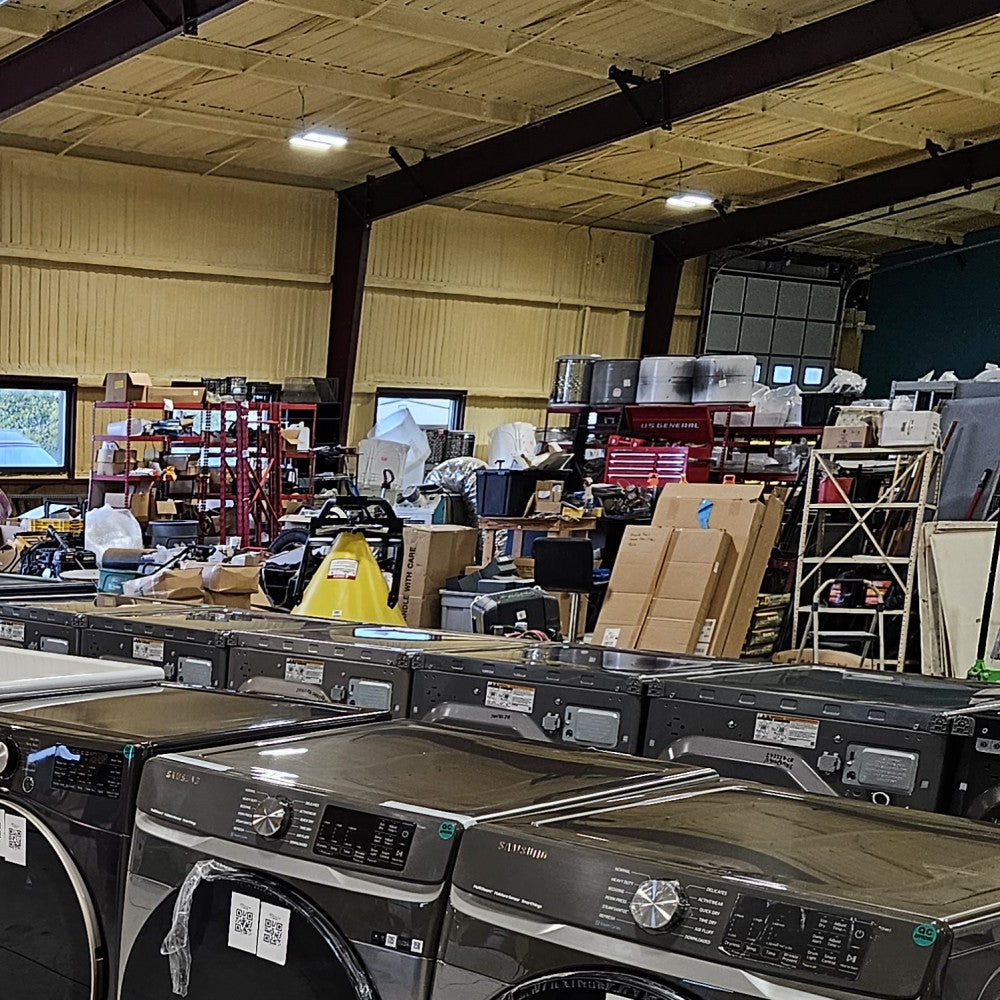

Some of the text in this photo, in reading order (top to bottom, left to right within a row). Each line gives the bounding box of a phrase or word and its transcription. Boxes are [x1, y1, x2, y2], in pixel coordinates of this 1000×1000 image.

[402, 546, 417, 622] ANDLE WITH CARE
[705, 887, 728, 896] DELICATES
[697, 897, 724, 906] ACTIVEWEAR
[918, 926, 934, 936] QC
